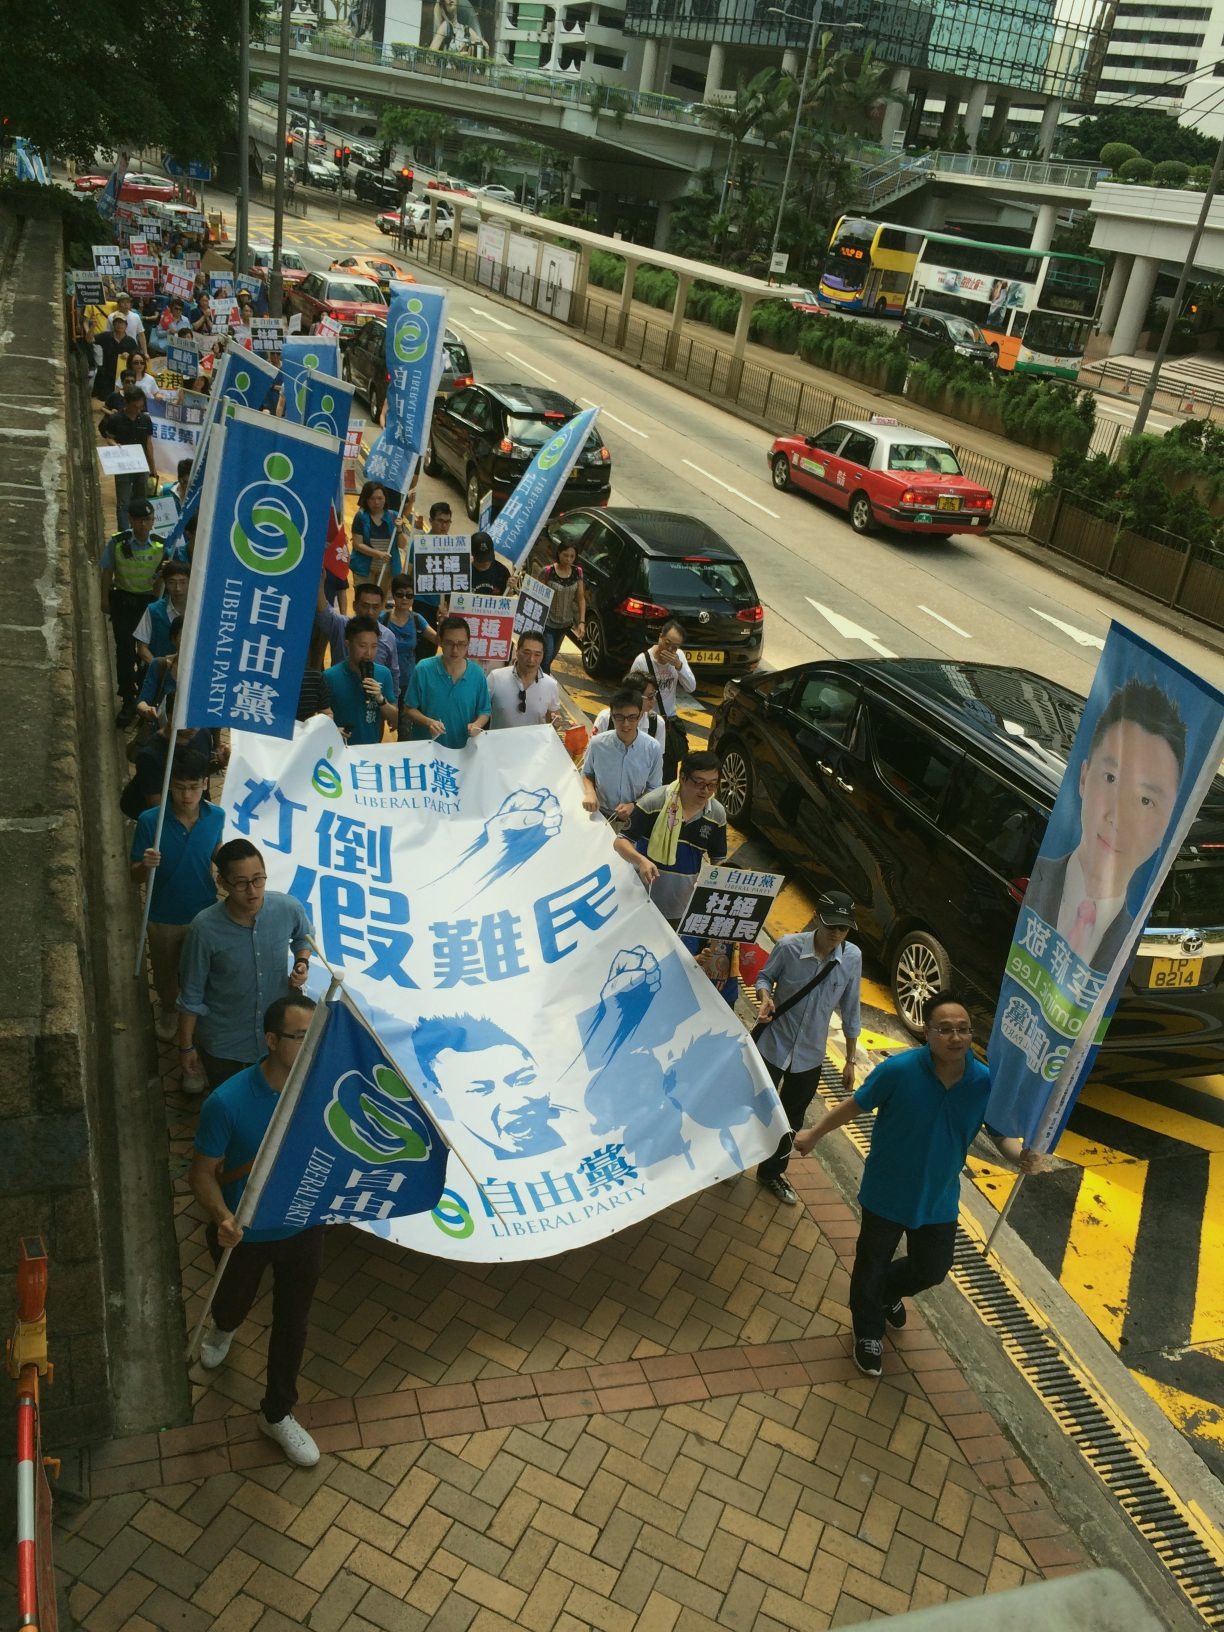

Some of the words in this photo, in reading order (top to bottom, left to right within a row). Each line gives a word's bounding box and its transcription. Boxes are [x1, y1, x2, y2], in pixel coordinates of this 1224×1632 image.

[425, 555, 461, 574] 杜絕
[417, 574, 469, 592] 假難民
[472, 595, 511, 610] 自由黨
[216, 578, 243, 656] LIBERAL
[229, 585, 292, 725] 自由黨
[468, 637, 508, 658] 難民
[696, 652, 720, 662] 6144
[207, 655, 232, 718] PARTY
[350, 757, 460, 797] 自由黨
[354, 794, 421, 810] LIBERAL
[423, 796, 462, 816] PARTY
[231, 777, 393, 884] 打倒
[727, 870, 777, 888] 自由黨
[705, 892, 758, 918] 杜絕
[288, 863, 620, 990] 假難民
[682, 913, 760, 940] 假難民
[1155, 971, 1194, 986] 8214
[1168, 958, 1189, 972] TP
[295, 1146, 337, 1199] LIBERAL
[478, 1143, 640, 1218] 自由黨
[320, 1168, 408, 1225] 自由
[491, 1212, 582, 1239] LIBERAL
[583, 1183, 648, 1219] PARTY
